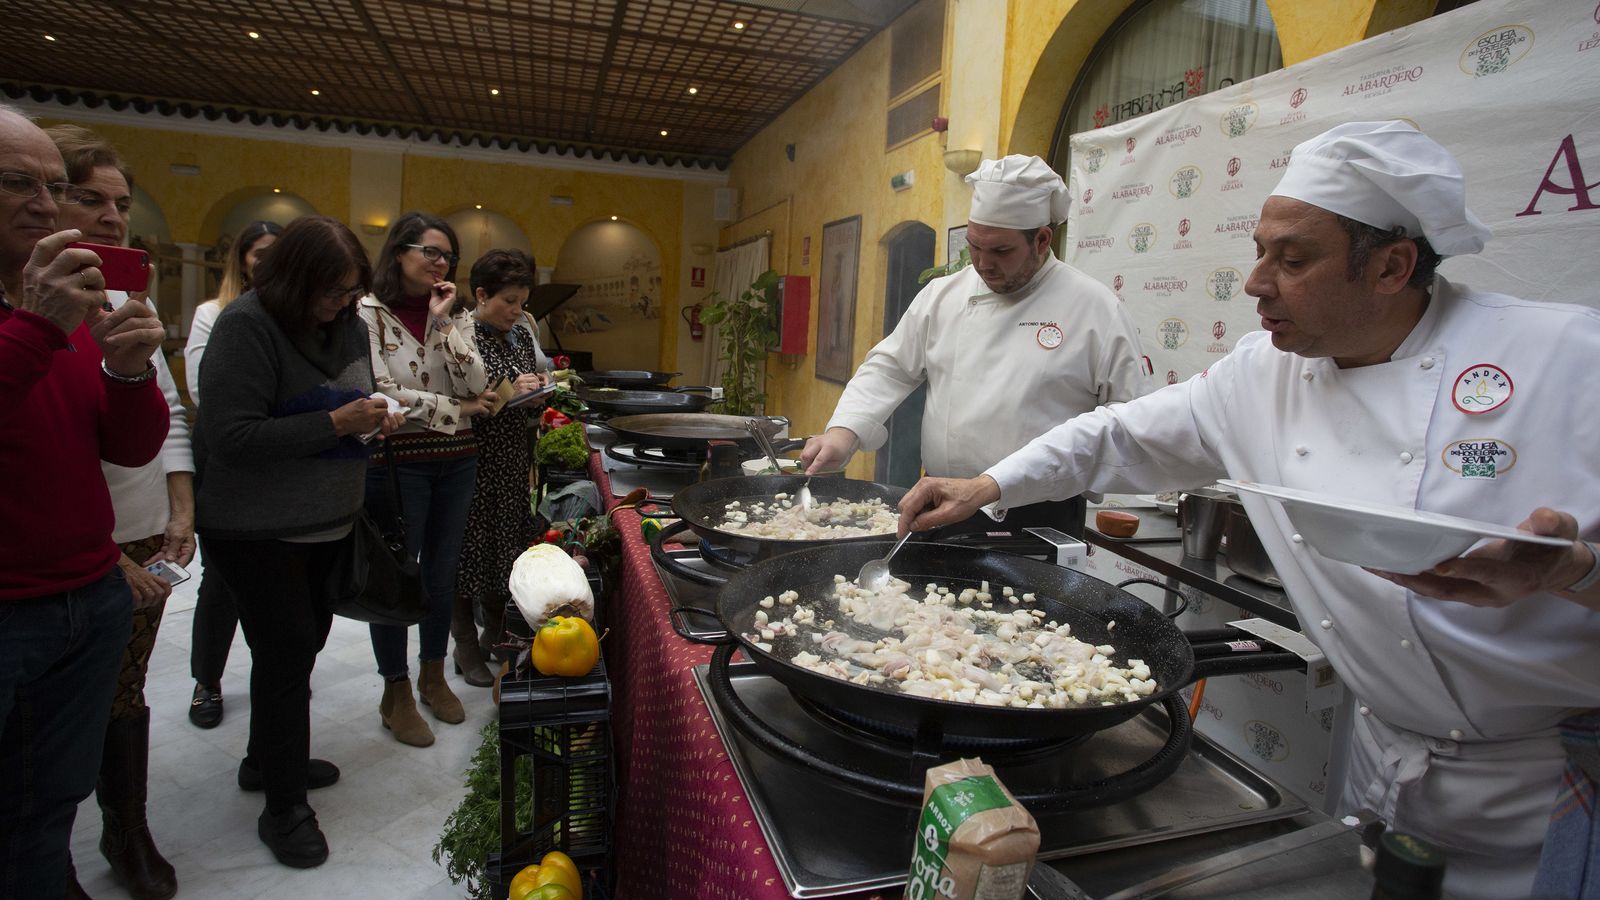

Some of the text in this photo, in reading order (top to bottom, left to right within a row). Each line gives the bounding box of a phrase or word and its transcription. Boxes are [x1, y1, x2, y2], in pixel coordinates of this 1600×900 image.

[1342, 66, 1424, 97] ALABARDERO
[1155, 124, 1202, 146] ALABARDERO
[1112, 184, 1154, 201] ALABARDERO
[1077, 236, 1115, 250] ALABARDERO
[1143, 280, 1188, 292] ALABARDERO
[1464, 370, 1507, 388] ANDEX
[1459, 441, 1499, 451] ESCUELA
[1461, 455, 1496, 464] SEVILLA
[928, 801, 954, 834] ARROZ
